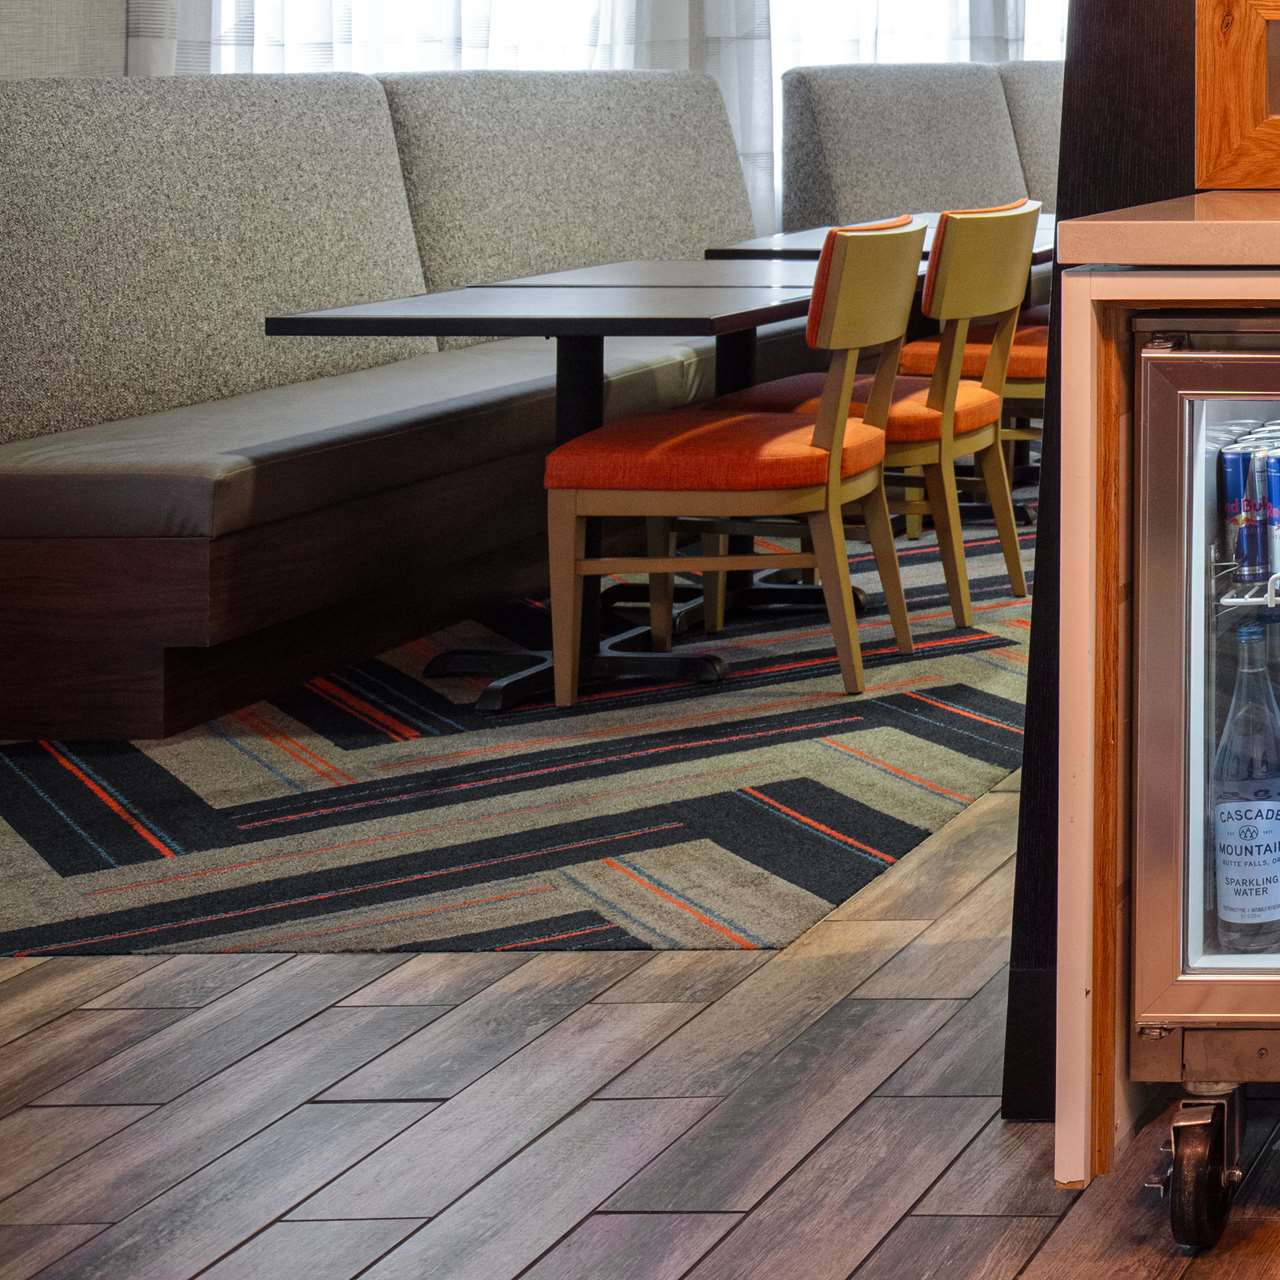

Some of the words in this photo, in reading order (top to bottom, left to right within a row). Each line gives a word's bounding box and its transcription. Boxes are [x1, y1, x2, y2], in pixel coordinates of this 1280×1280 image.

[1222, 859, 1243, 867] BUTTE
[1245, 859, 1269, 867] FALLS,
[1225, 876, 1279, 887] SPARKLING
[1234, 885, 1269, 896] WATER
